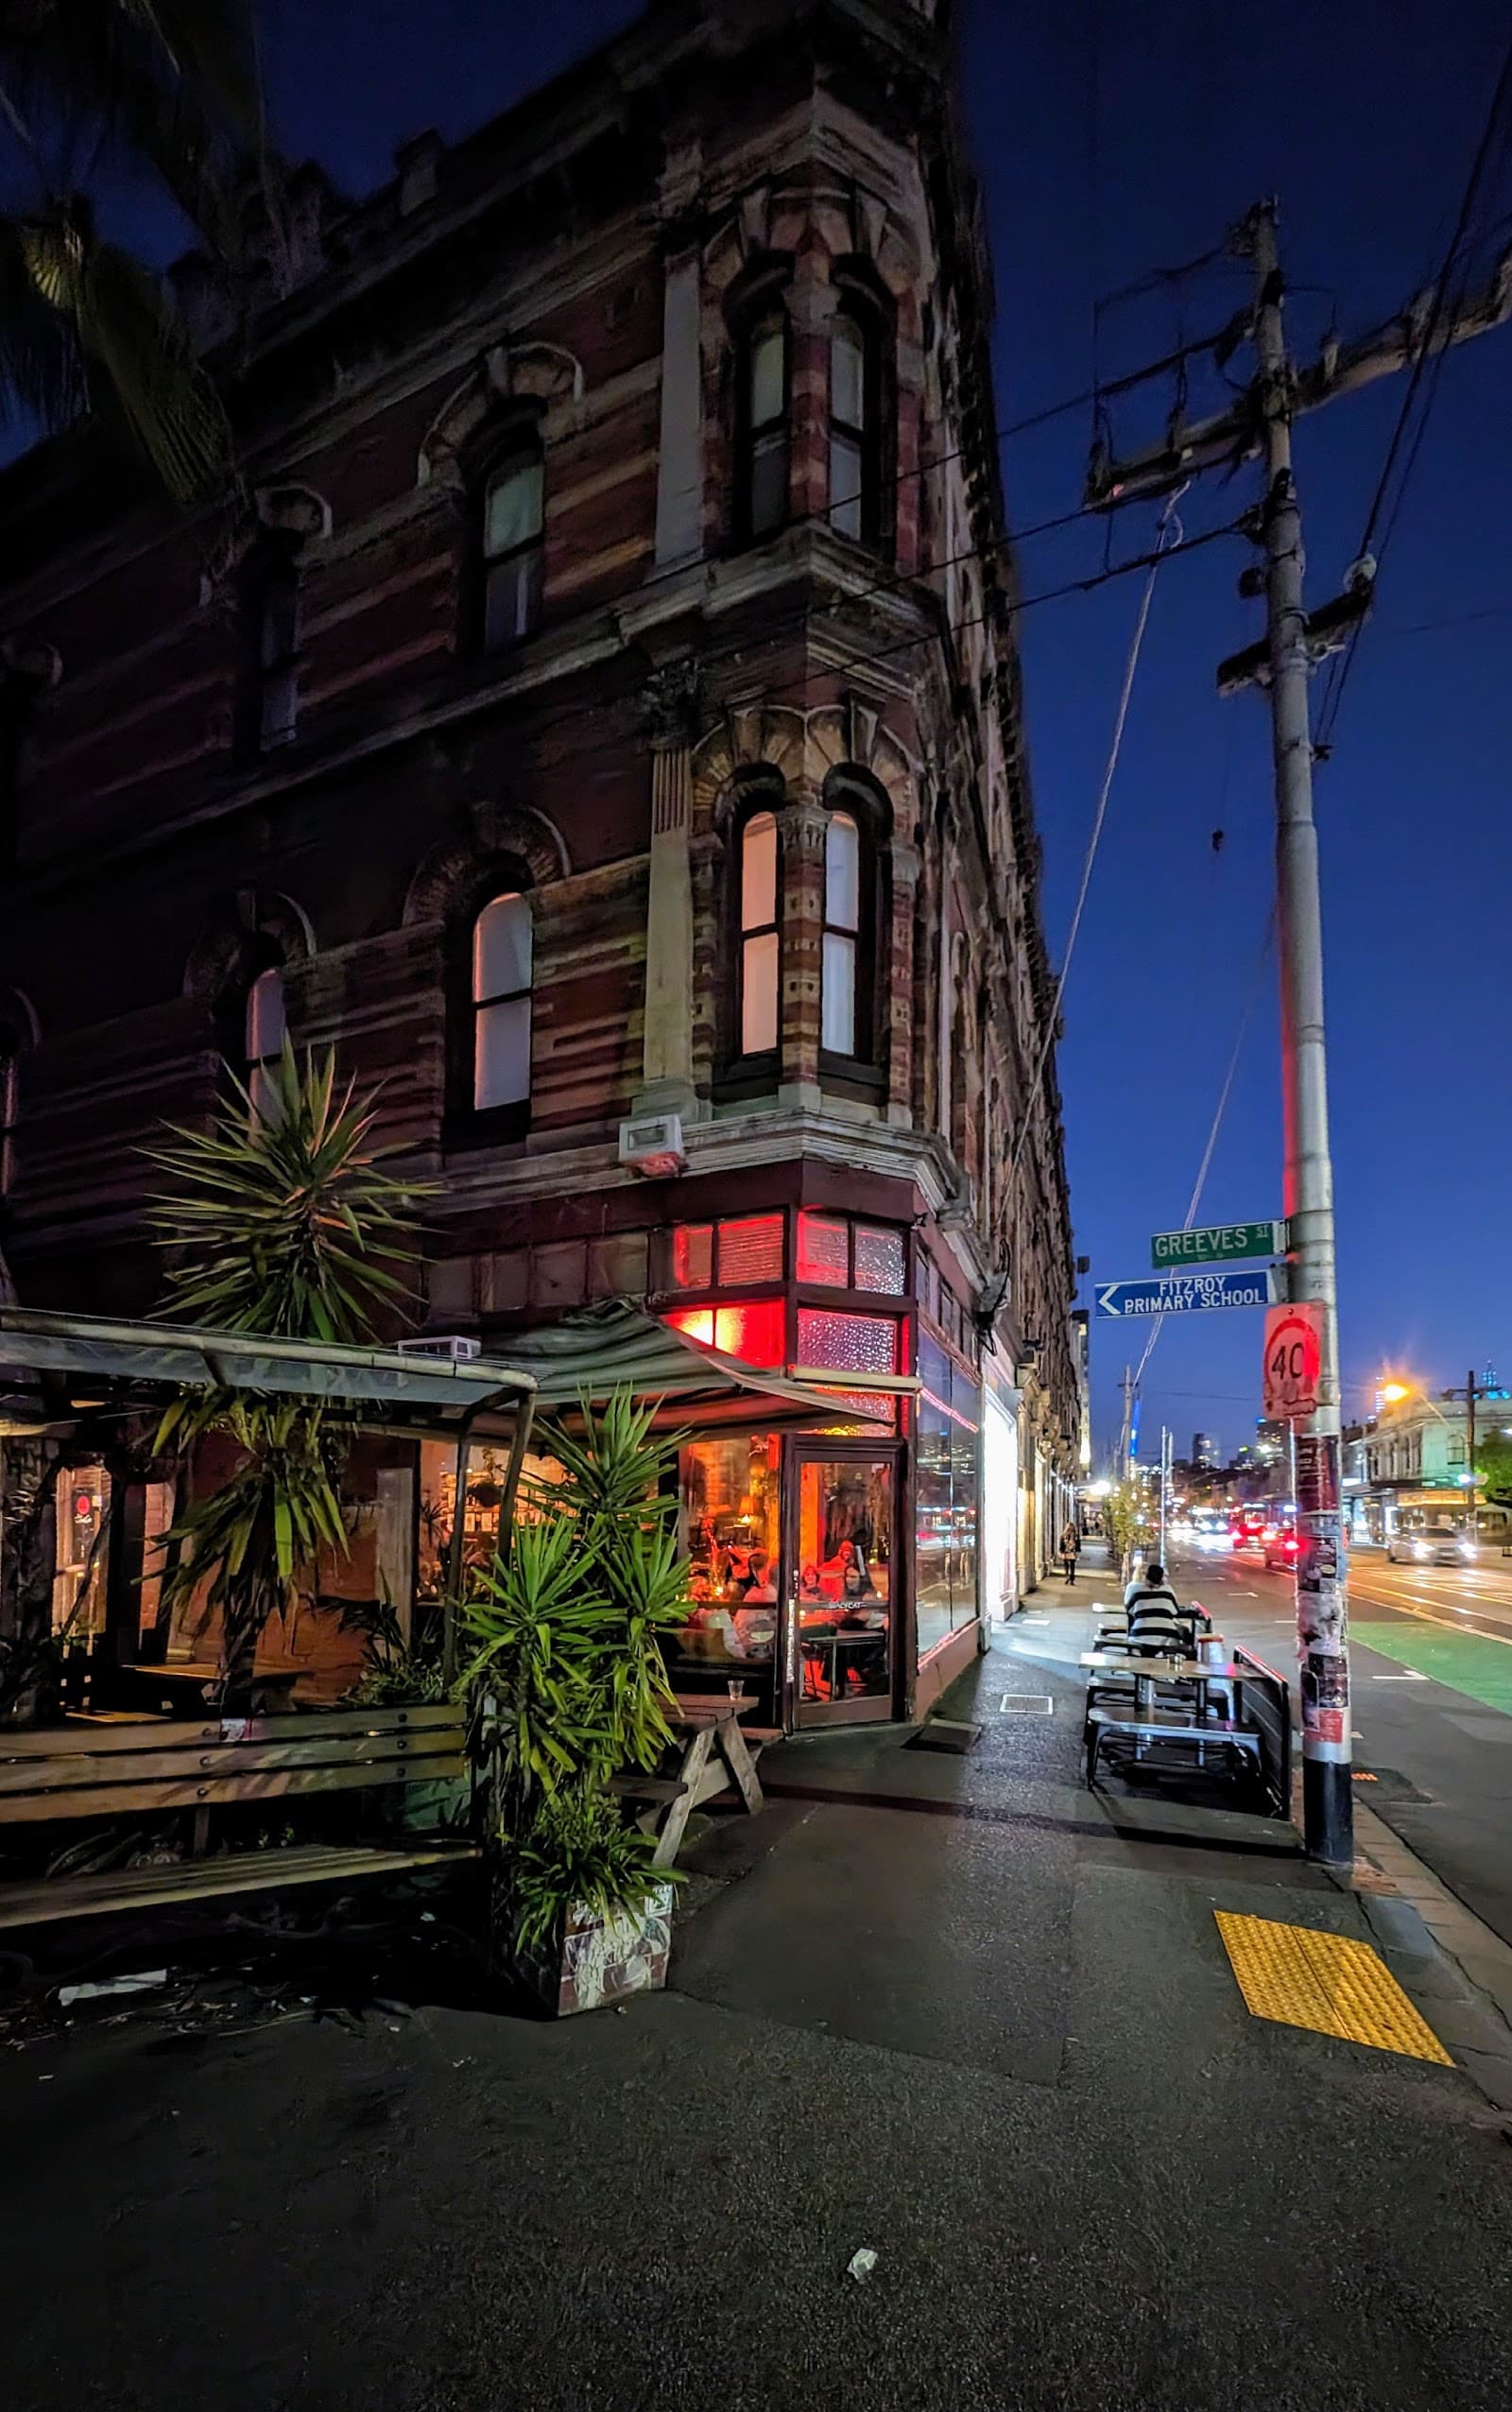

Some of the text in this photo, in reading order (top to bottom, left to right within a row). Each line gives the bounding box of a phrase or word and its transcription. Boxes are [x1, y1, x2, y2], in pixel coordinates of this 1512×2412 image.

[1155, 1228, 1247, 1257] GREEVES
[1256, 1224, 1269, 1237] ST
[1124, 1288, 1264, 1314] PRIMARY SCHOOL
[1160, 1276, 1227, 1297] FITZROY
[1271, 1341, 1305, 1380] 40
